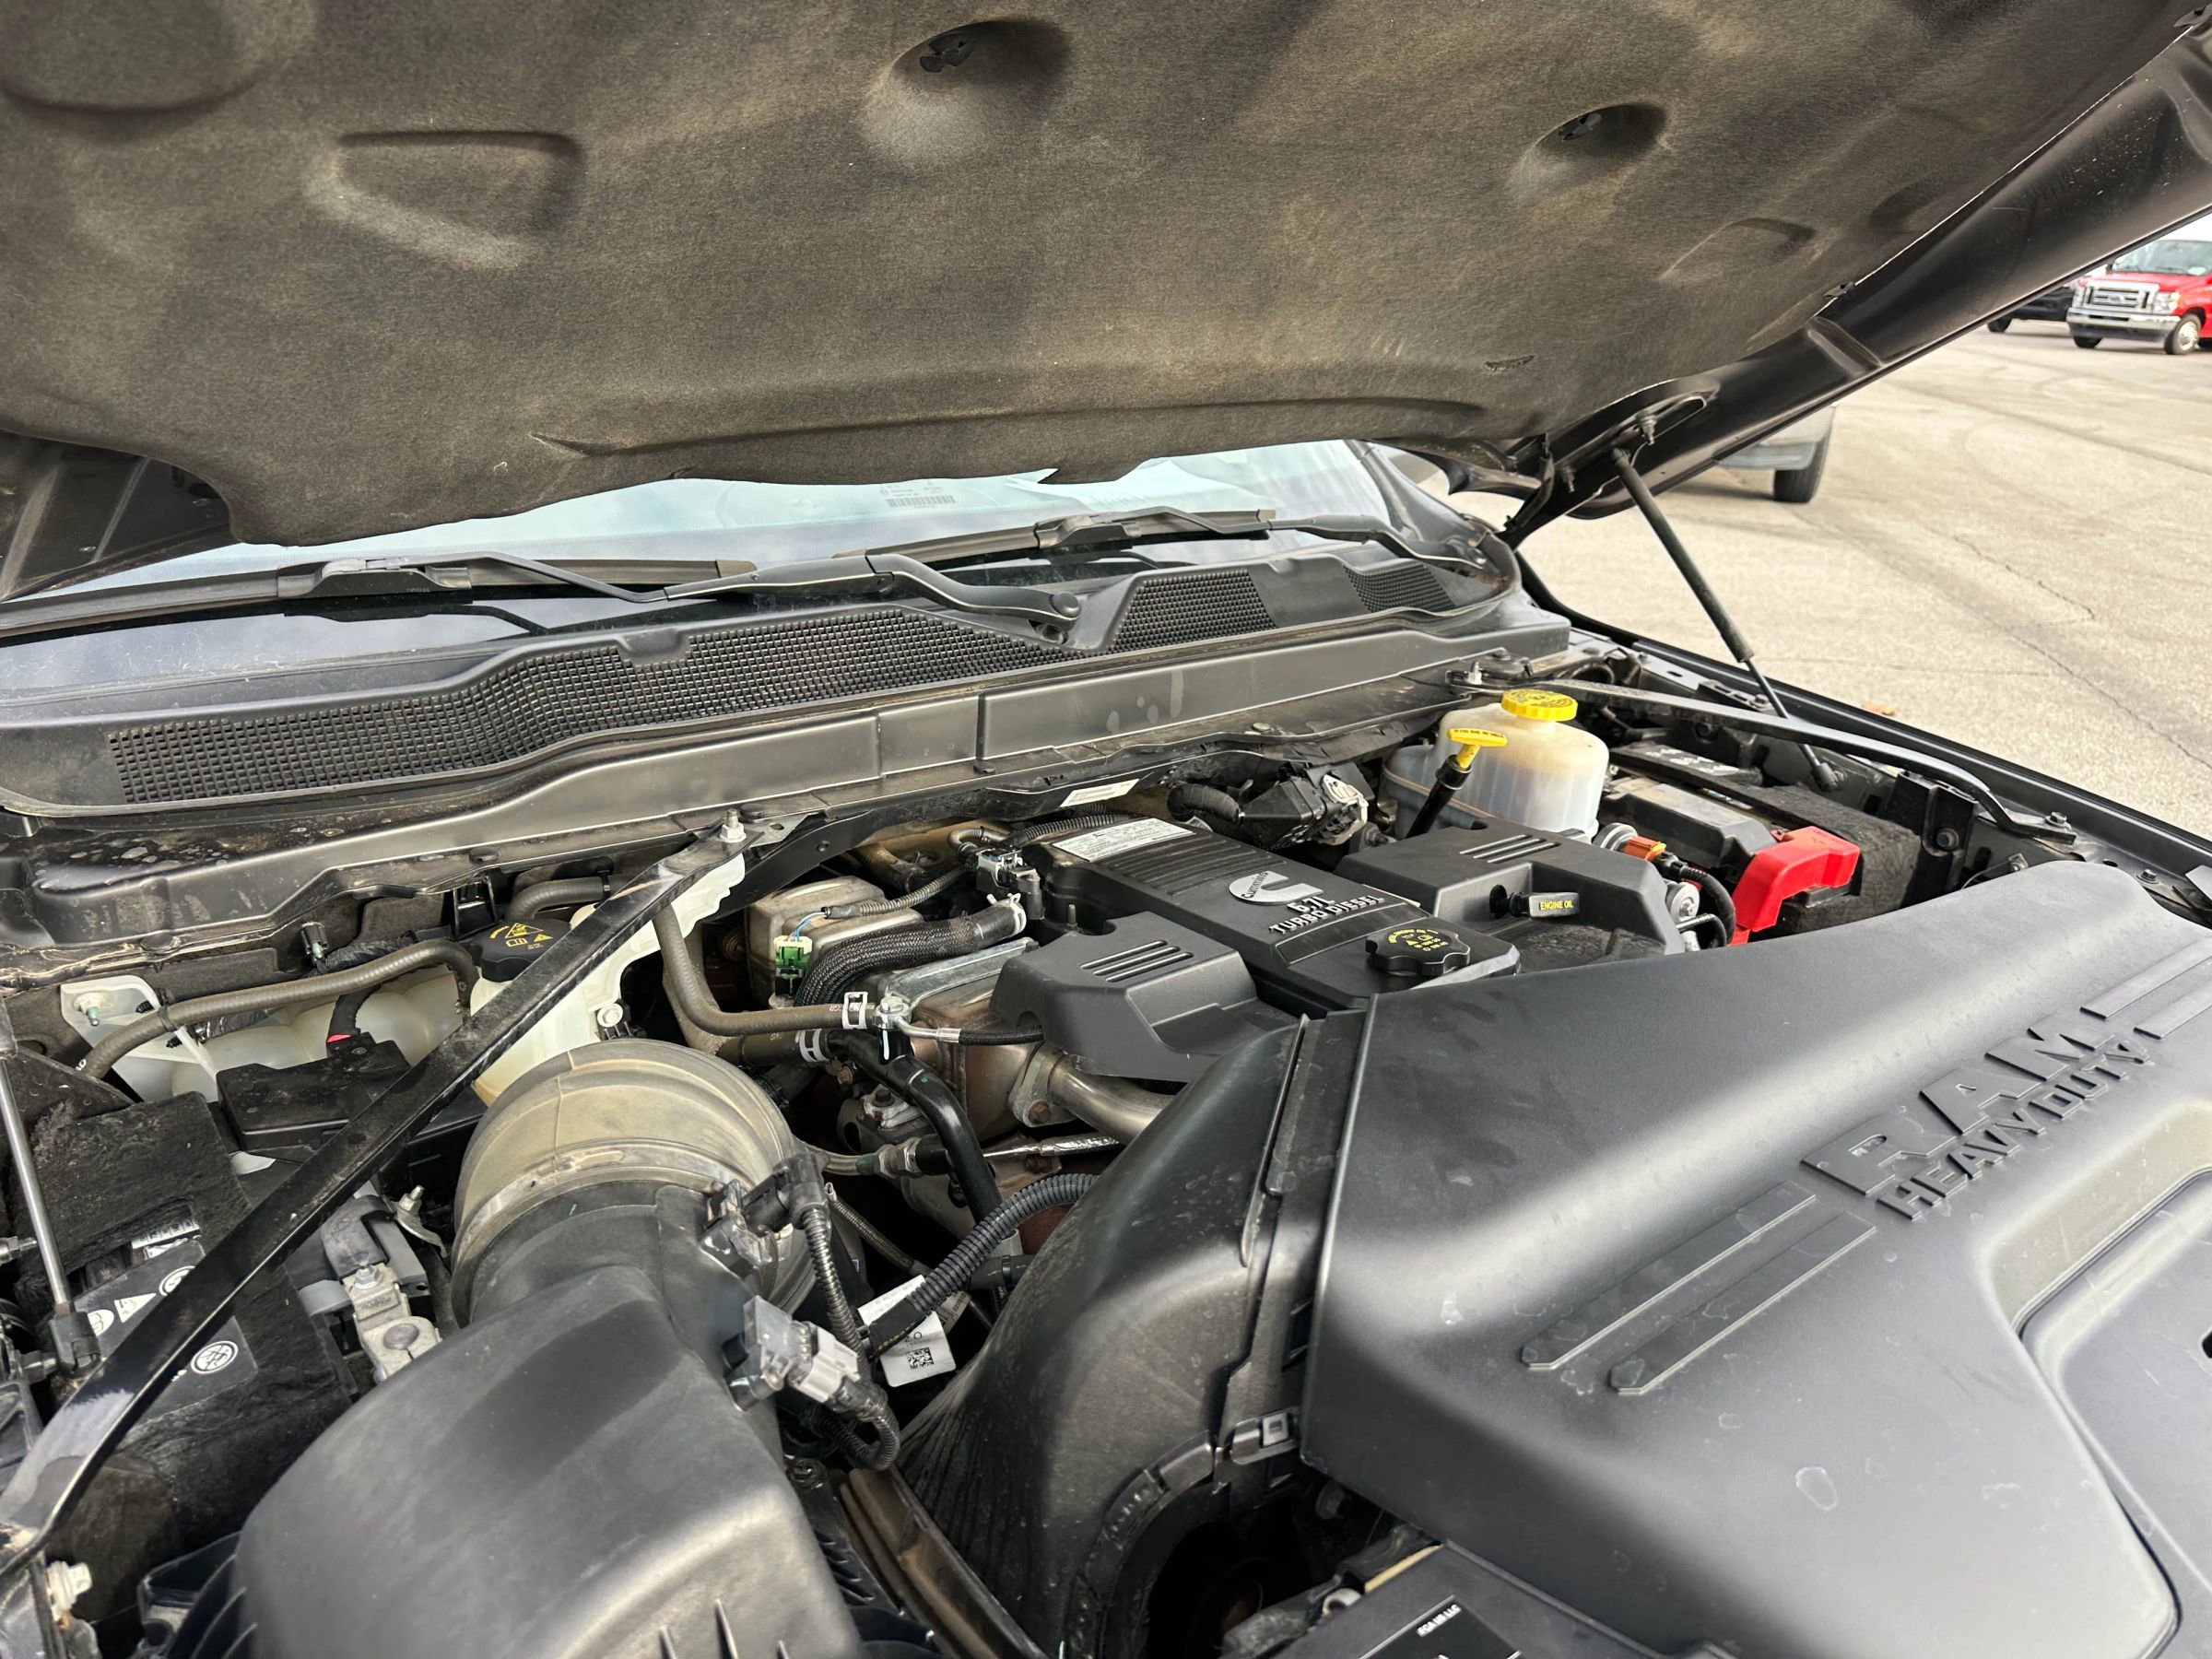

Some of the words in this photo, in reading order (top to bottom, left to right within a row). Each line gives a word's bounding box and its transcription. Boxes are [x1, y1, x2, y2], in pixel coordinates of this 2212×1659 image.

[1268, 910, 1329, 935] TURBO
[1325, 895, 1384, 915] DIESEL
[1287, 896, 1335, 913] 6.7L
[1540, 900, 1563, 910] ENGINE
[1563, 900, 1573, 909] OIL
[1800, 1014, 2116, 1195] RAM
[1876, 1108, 2046, 1220] HEAVY
[2028, 1041, 2155, 1119] DUTY
